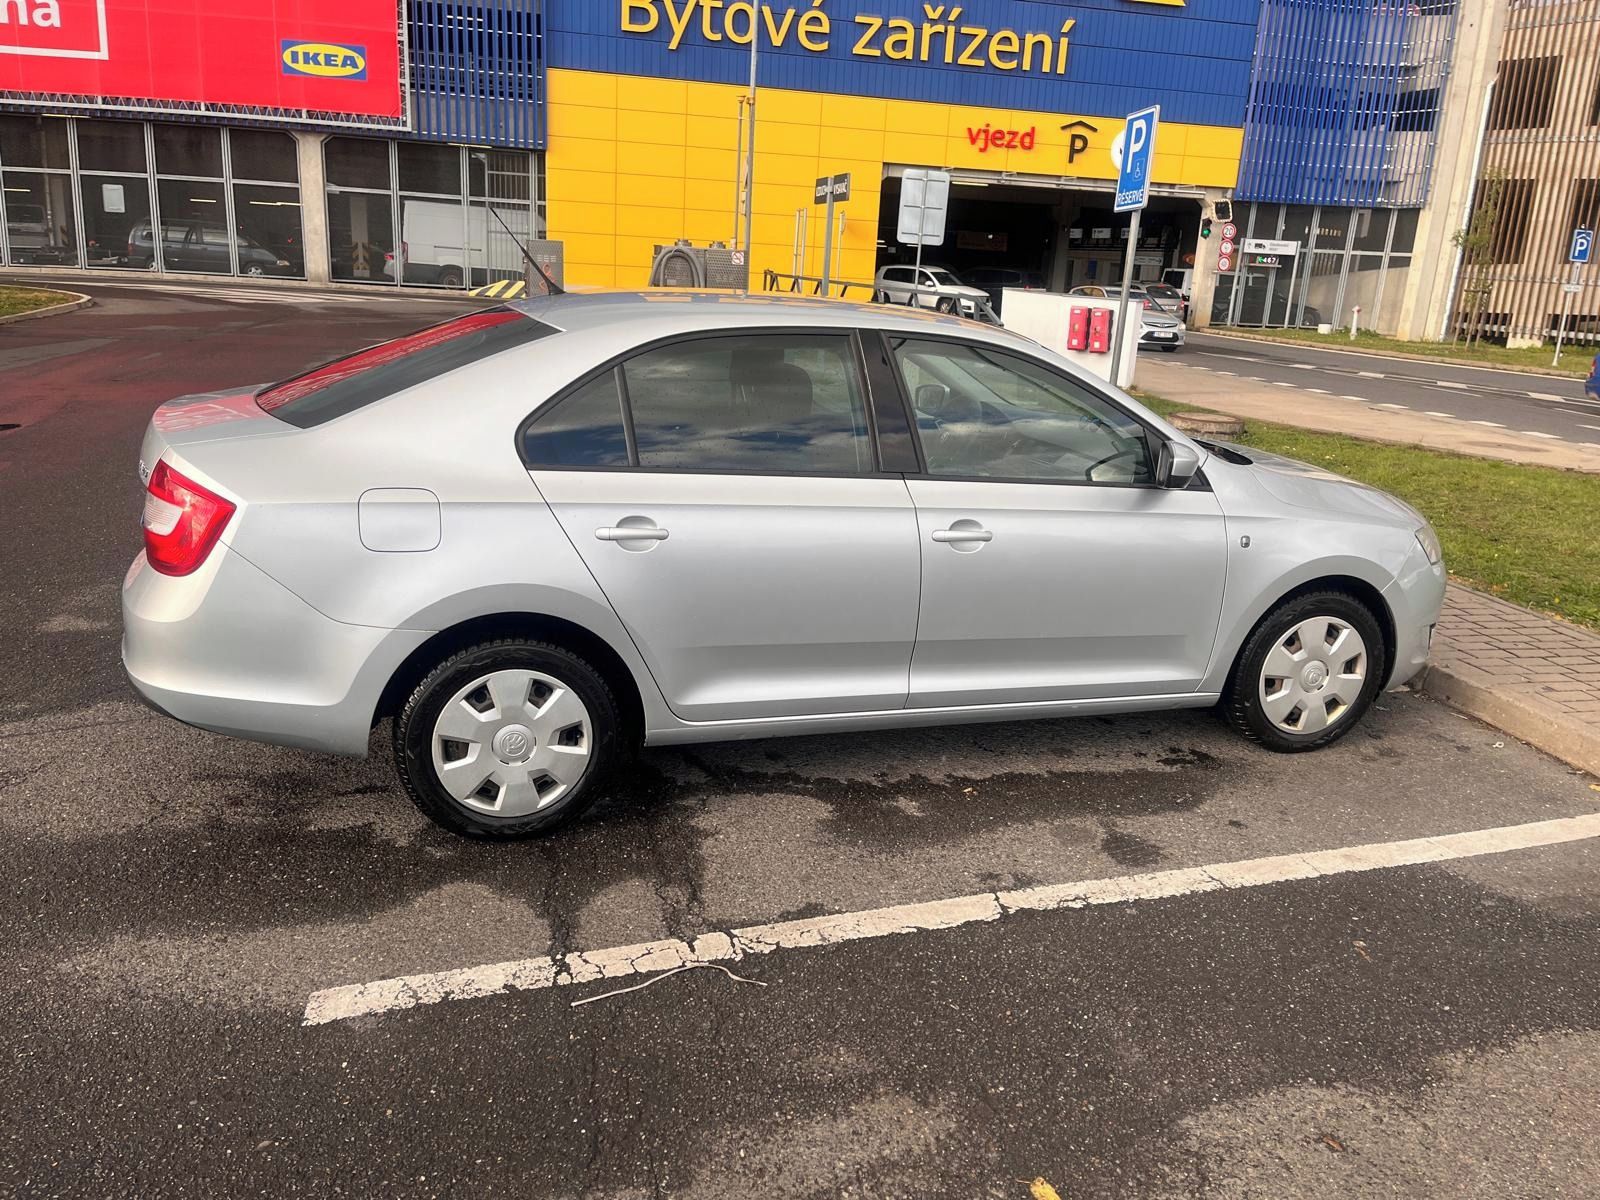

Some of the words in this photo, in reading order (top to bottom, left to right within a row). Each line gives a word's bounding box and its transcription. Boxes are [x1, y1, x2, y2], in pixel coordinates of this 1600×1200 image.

[620, 0, 831, 51] Bytové
[852, 4, 1076, 74] zařízení
[290, 50, 360, 70] IKEA
[967, 123, 1035, 152] vjezd
[1127, 119, 1146, 173] P
[1224, 227, 1234, 236] 20
[1574, 239, 1587, 256] P
